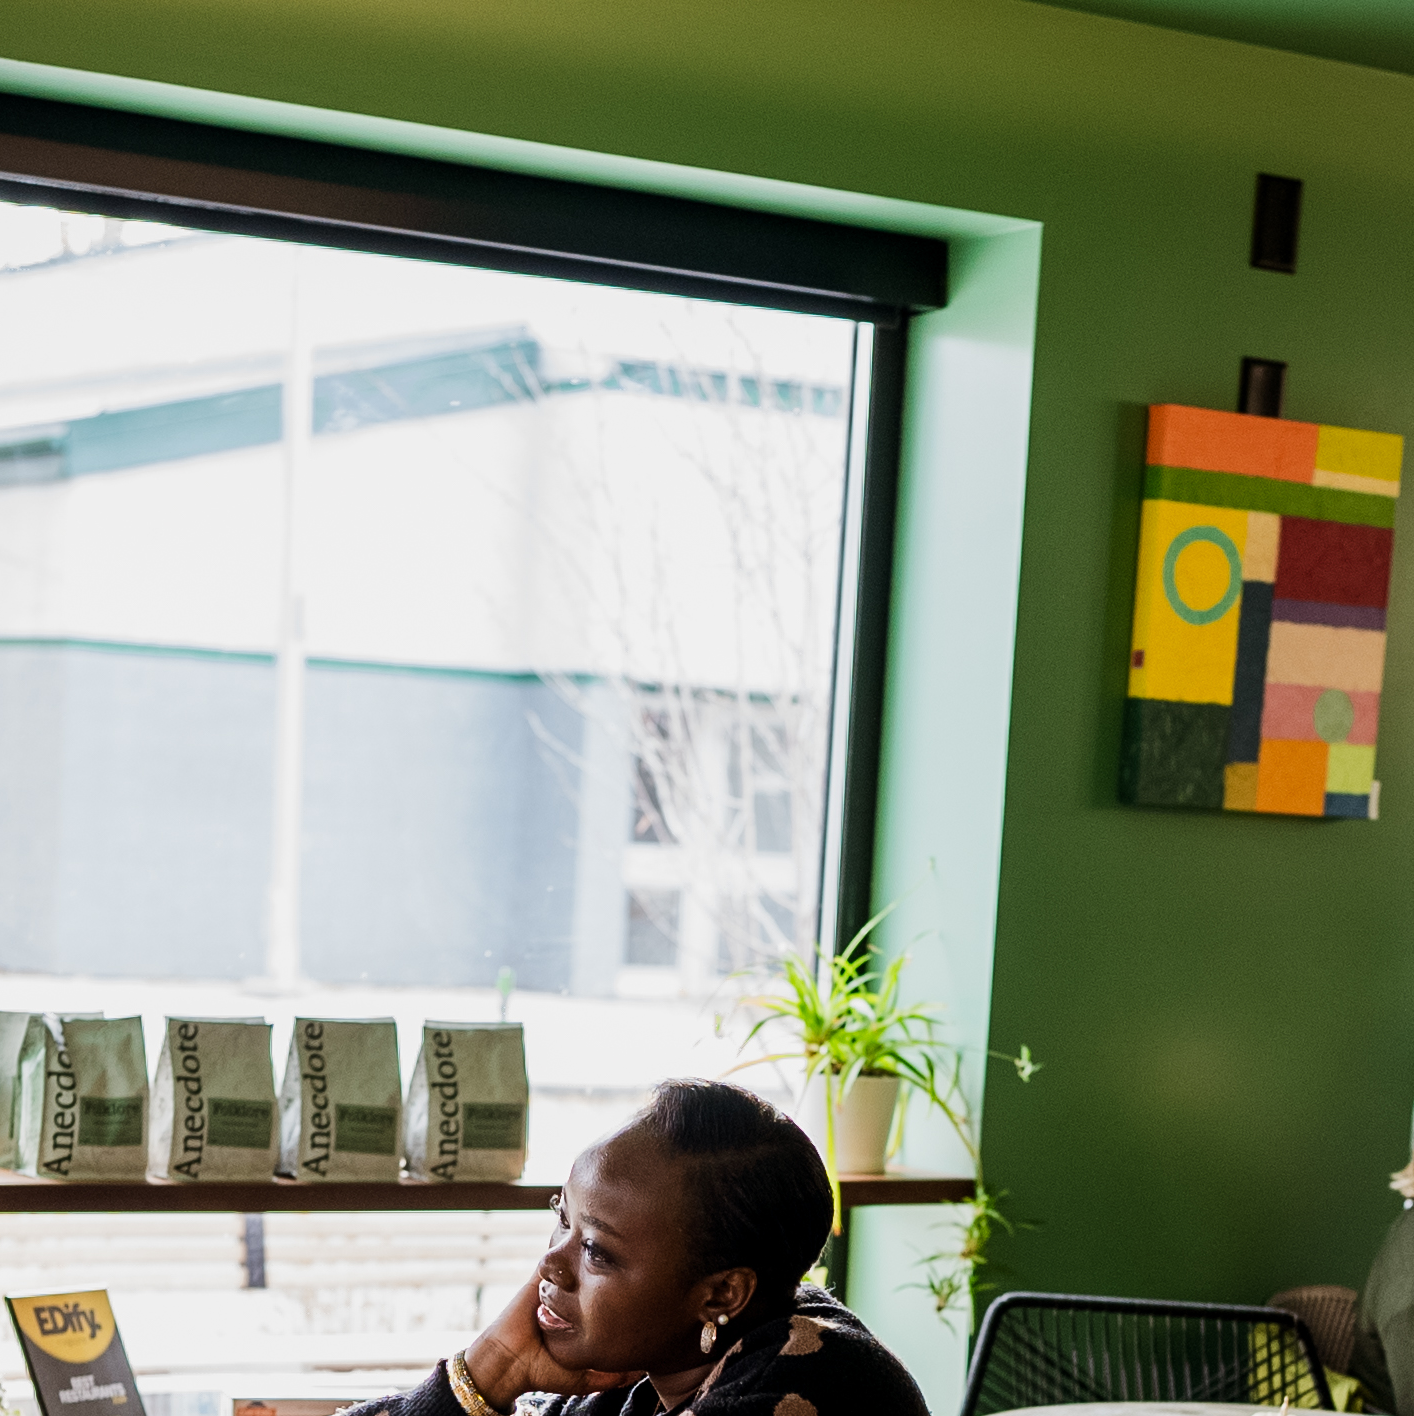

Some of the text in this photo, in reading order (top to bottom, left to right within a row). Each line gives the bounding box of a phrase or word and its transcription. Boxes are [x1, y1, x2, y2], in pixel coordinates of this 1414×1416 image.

[43, 1051, 77, 1176] Anecdo
[174, 1022, 205, 1180] Anecdote
[302, 1022, 331, 1178] Anecdote
[431, 1031, 459, 1181] Anecdote
